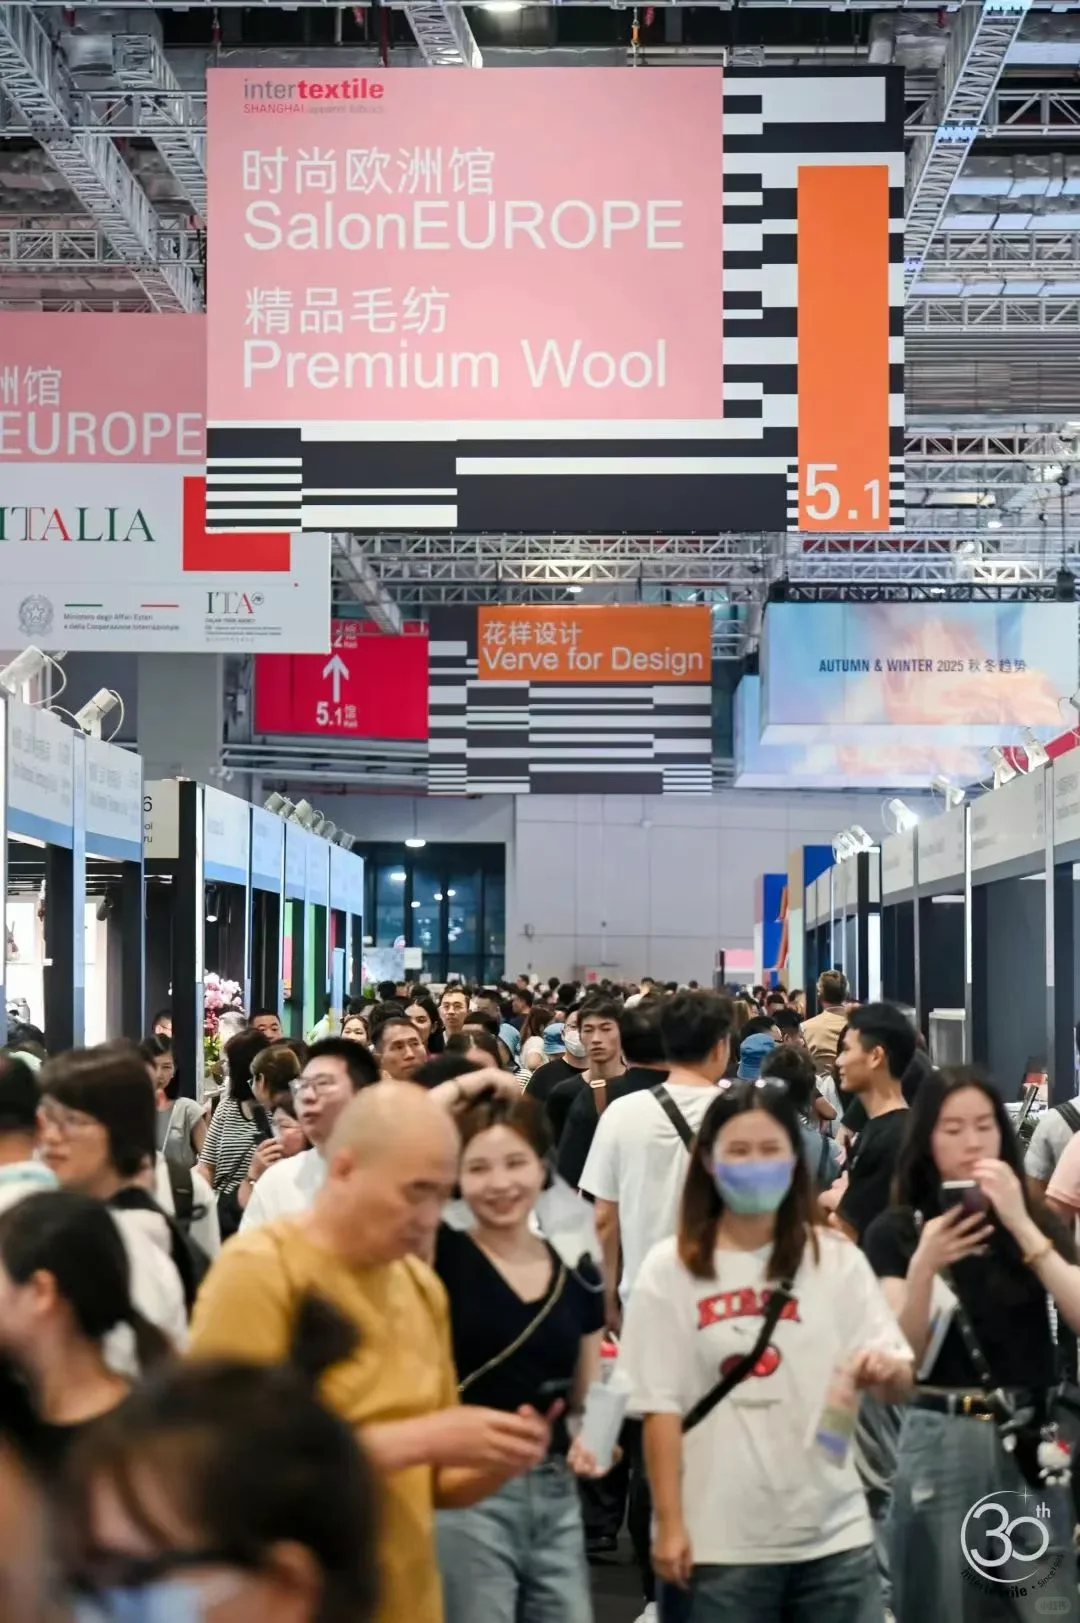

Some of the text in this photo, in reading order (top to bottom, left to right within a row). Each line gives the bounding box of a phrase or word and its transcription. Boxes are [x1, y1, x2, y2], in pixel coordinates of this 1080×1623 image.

[244, 78, 384, 100] intertextile
[244, 103, 304, 114] SHANGHAI
[242, 147, 495, 195] 时尚欧洲馆
[244, 200, 684, 251] SalonEUROPE
[245, 286, 450, 335] 精品毛纺
[243, 339, 666, 388] Premium Wool
[0, 411, 202, 456] EUROPE
[805, 463, 880, 520] 5.1
[0, 506, 155, 541] ITALIA
[206, 591, 254, 614] ITA
[482, 622, 583, 646] 花样设计
[482, 647, 704, 676] Verve for Design
[819, 659, 870, 673] AUTUMN
[875, 659, 883, 672] &
[887, 659, 933, 673] WINTER
[937, 659, 964, 672] 2025
[316, 701, 342, 727] 5.1
